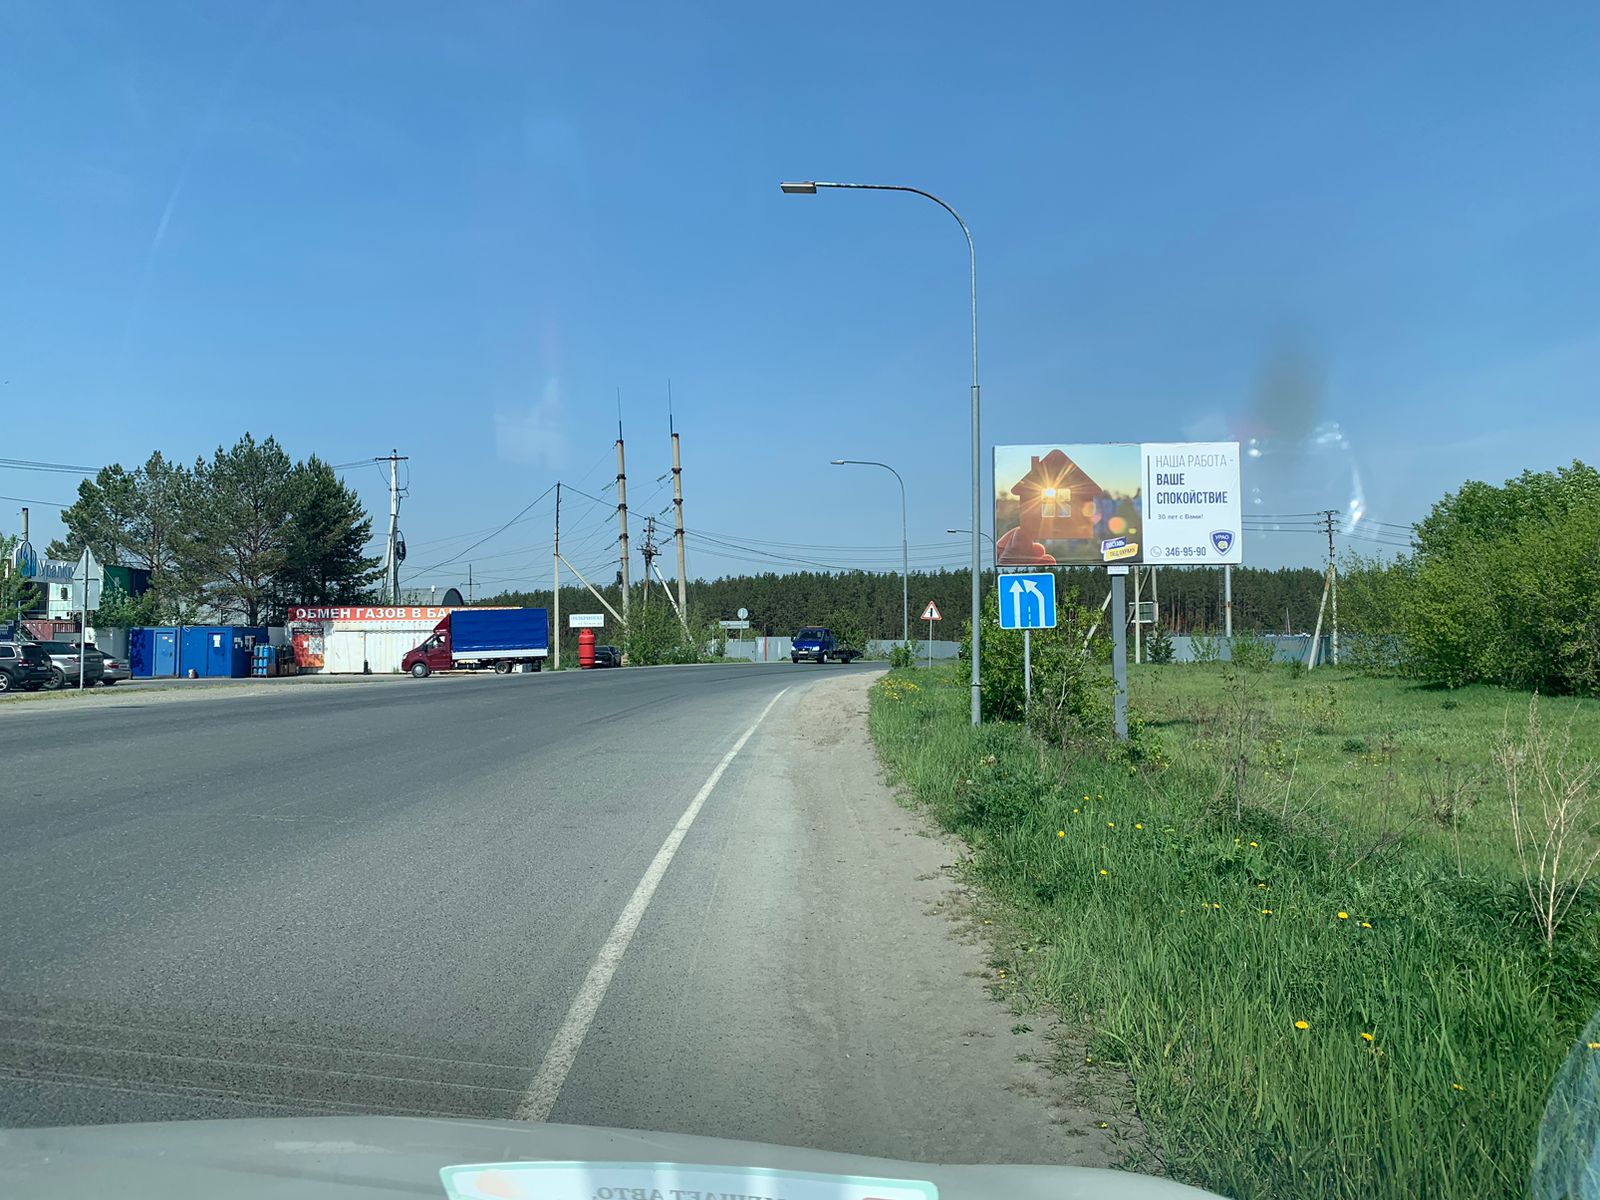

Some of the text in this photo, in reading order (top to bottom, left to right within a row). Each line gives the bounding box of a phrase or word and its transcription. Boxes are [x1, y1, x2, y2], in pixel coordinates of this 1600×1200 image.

[1155, 454, 1186, 468] НАША
[1188, 454, 1227, 467] РАБОТА
[1156, 473, 1185, 486] ВАШЕ
[1156, 489, 1228, 504] СПОКОЙСТВИЕ
[1165, 546, 1206, 557] 346-95-90
[38, 559, 78, 581] УралКр
[296, 608, 351, 619] ОБМЕН
[355, 607, 406, 618] ГАЗОВ
[411, 607, 422, 618] В
